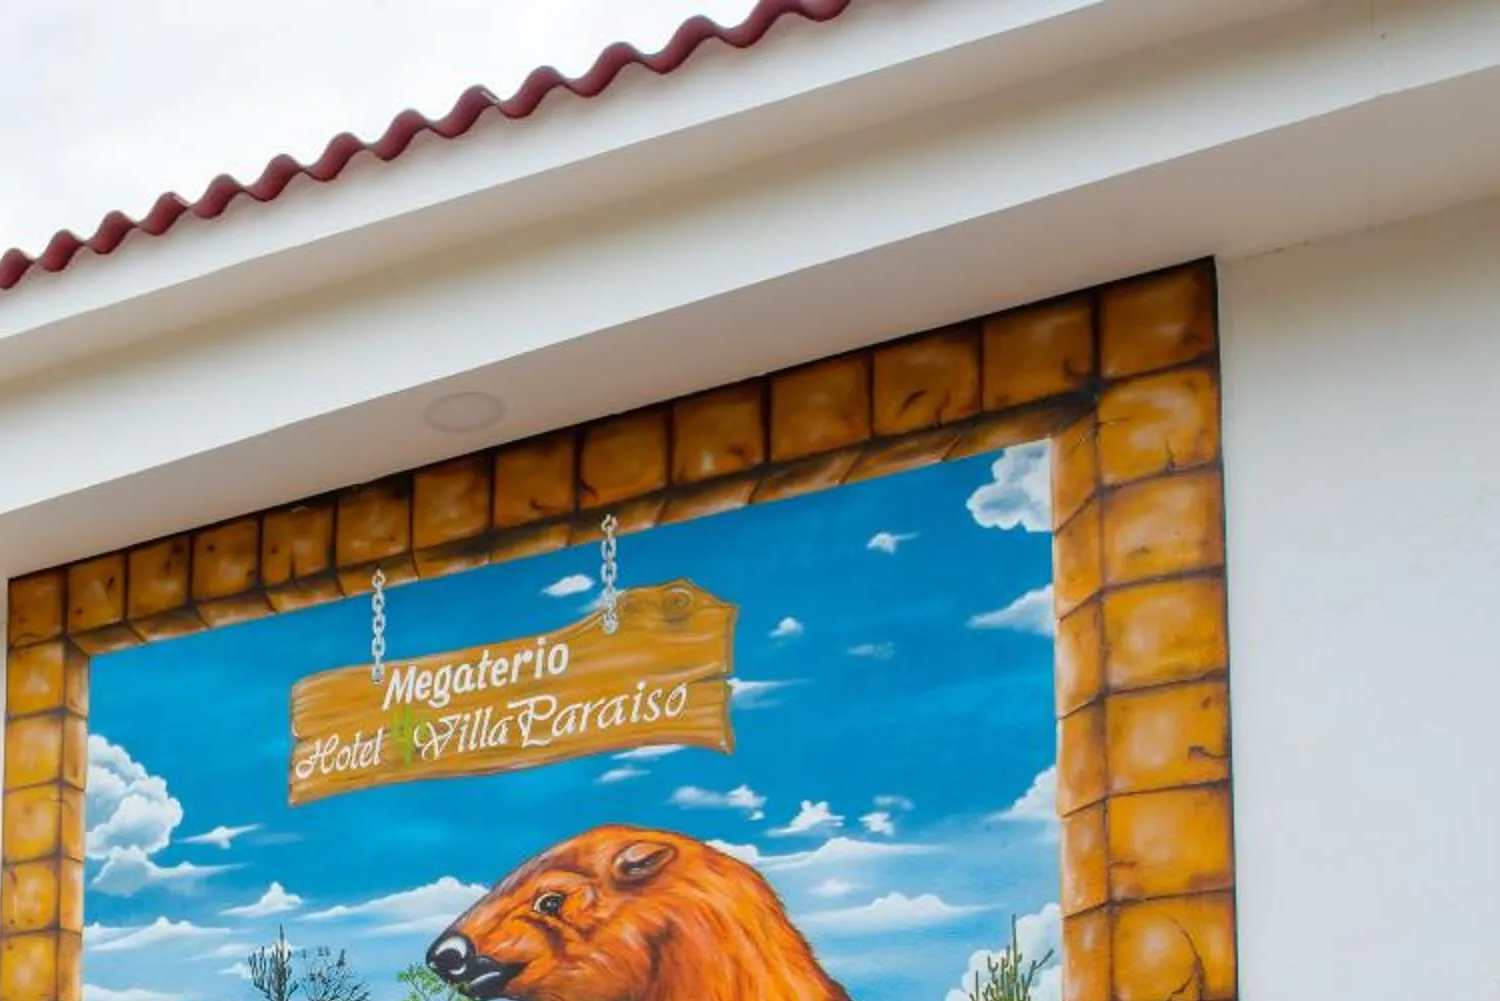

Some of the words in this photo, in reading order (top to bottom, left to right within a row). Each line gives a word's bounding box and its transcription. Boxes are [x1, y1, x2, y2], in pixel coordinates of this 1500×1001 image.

[382, 638, 570, 711] Megaterio
[295, 728, 384, 779] Hotel
[413, 713, 509, 762] Villa
[507, 681, 688, 749] Paraiso
